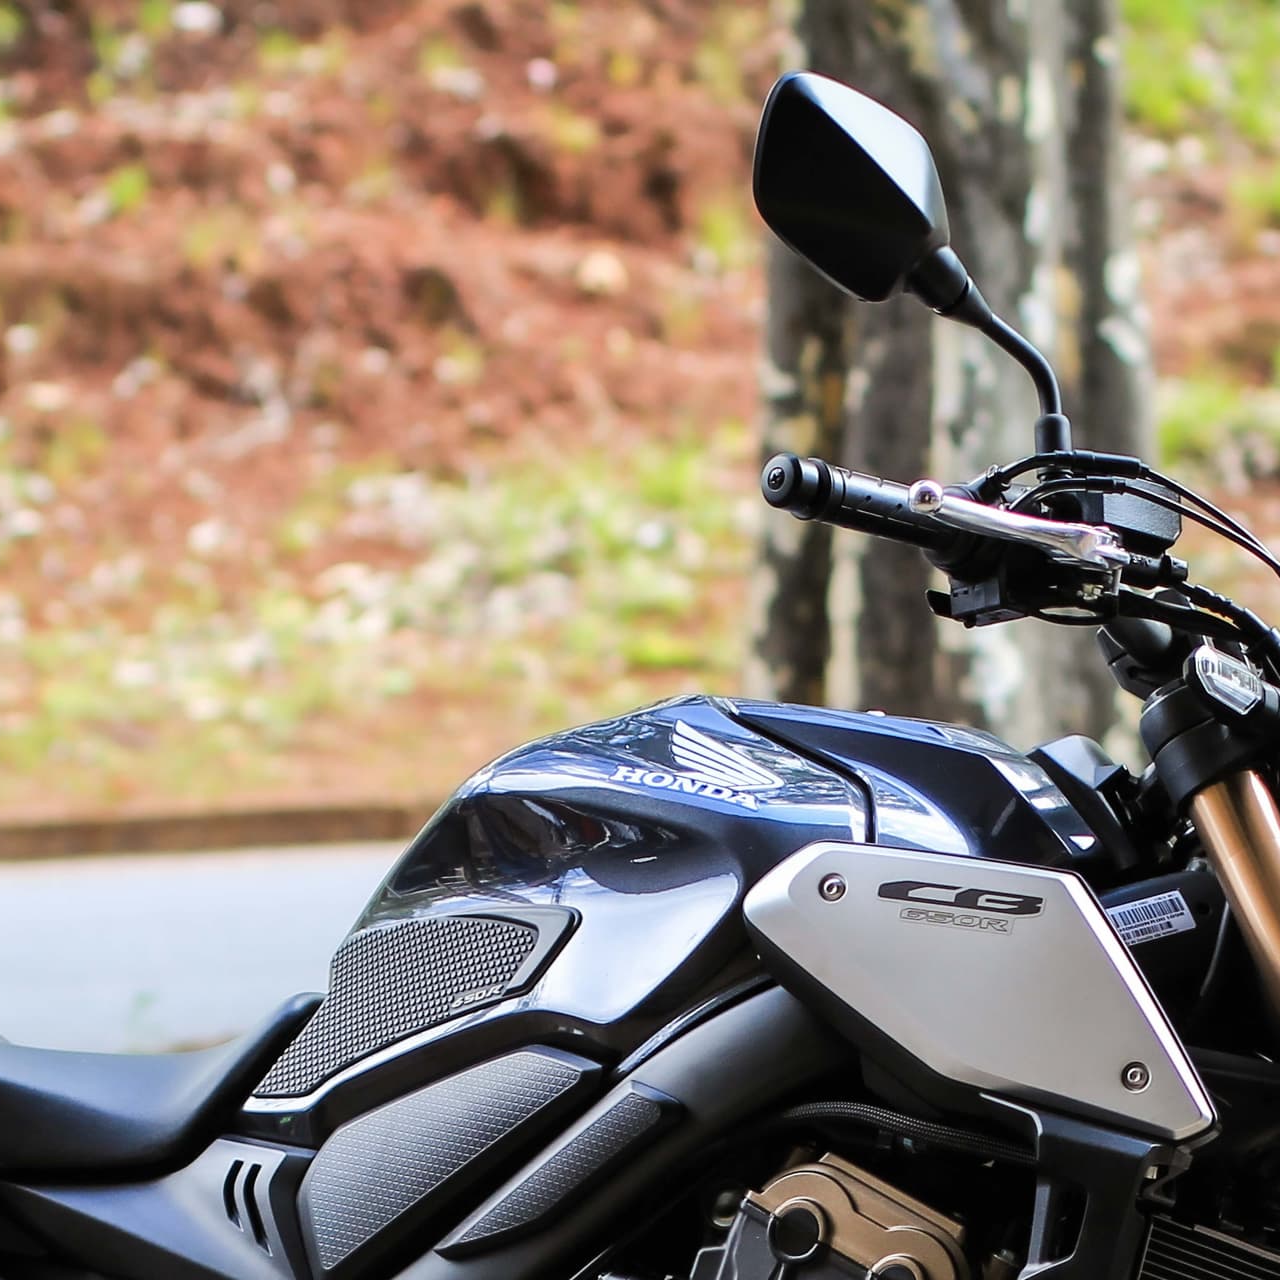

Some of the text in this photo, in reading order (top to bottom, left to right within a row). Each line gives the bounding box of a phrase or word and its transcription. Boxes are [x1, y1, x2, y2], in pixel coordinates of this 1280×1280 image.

[609, 765, 760, 812] HONDA
[878, 879, 1044, 916] CB
[899, 907, 1009, 933] 650R
[451, 984, 504, 1008] 650R
